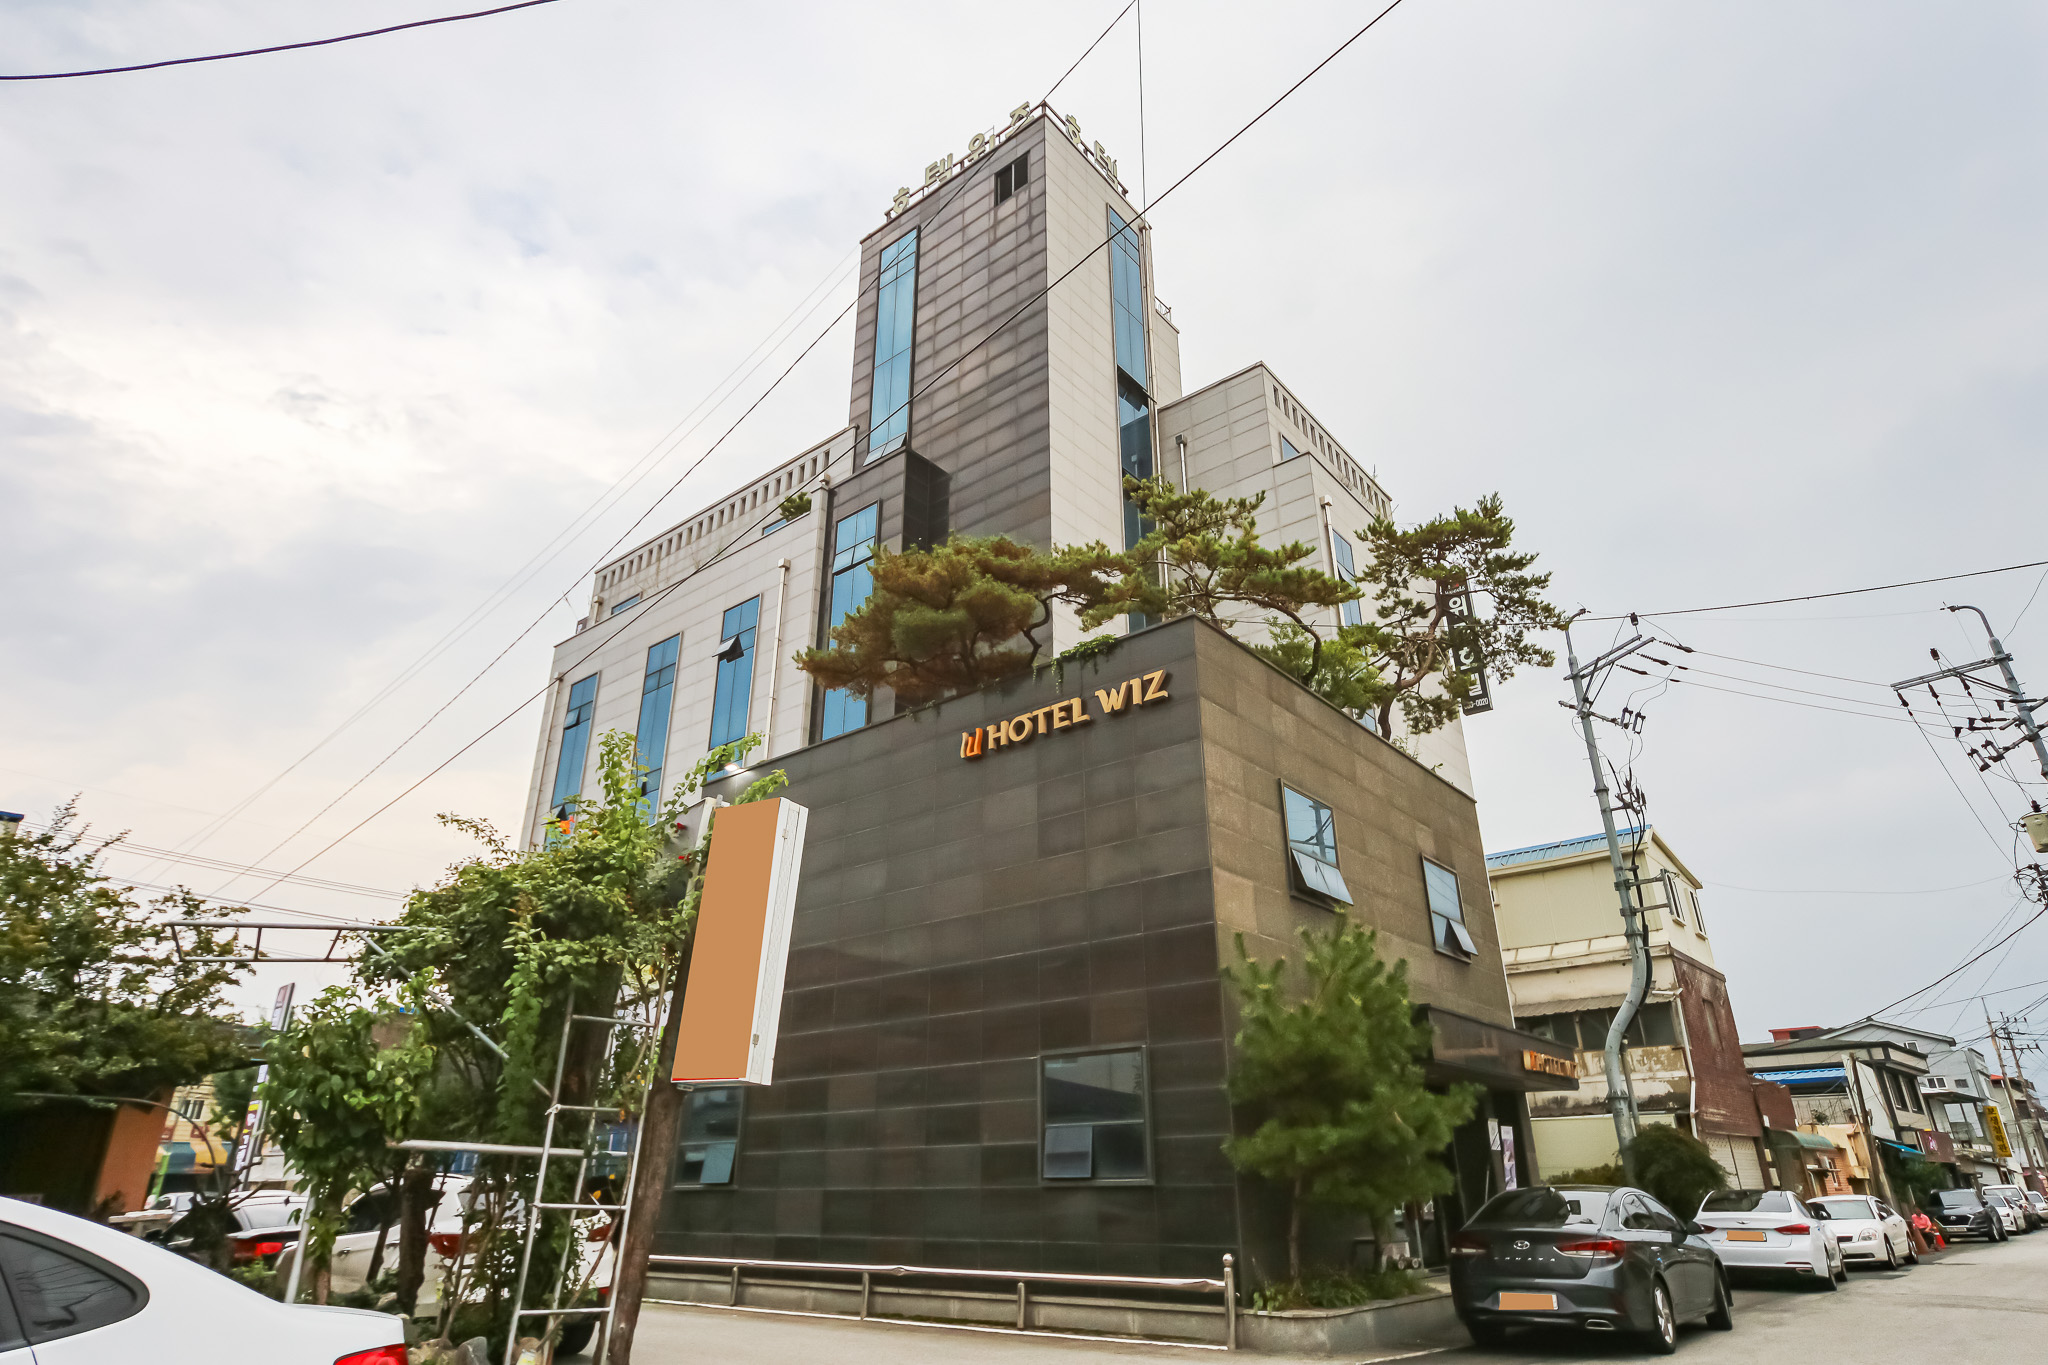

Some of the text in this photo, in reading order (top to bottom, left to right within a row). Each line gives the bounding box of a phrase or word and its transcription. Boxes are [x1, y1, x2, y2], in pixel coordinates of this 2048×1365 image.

[1065, 114, 1119, 191] 호텔
[986, 669, 1169, 750] HOTEL WIZ
